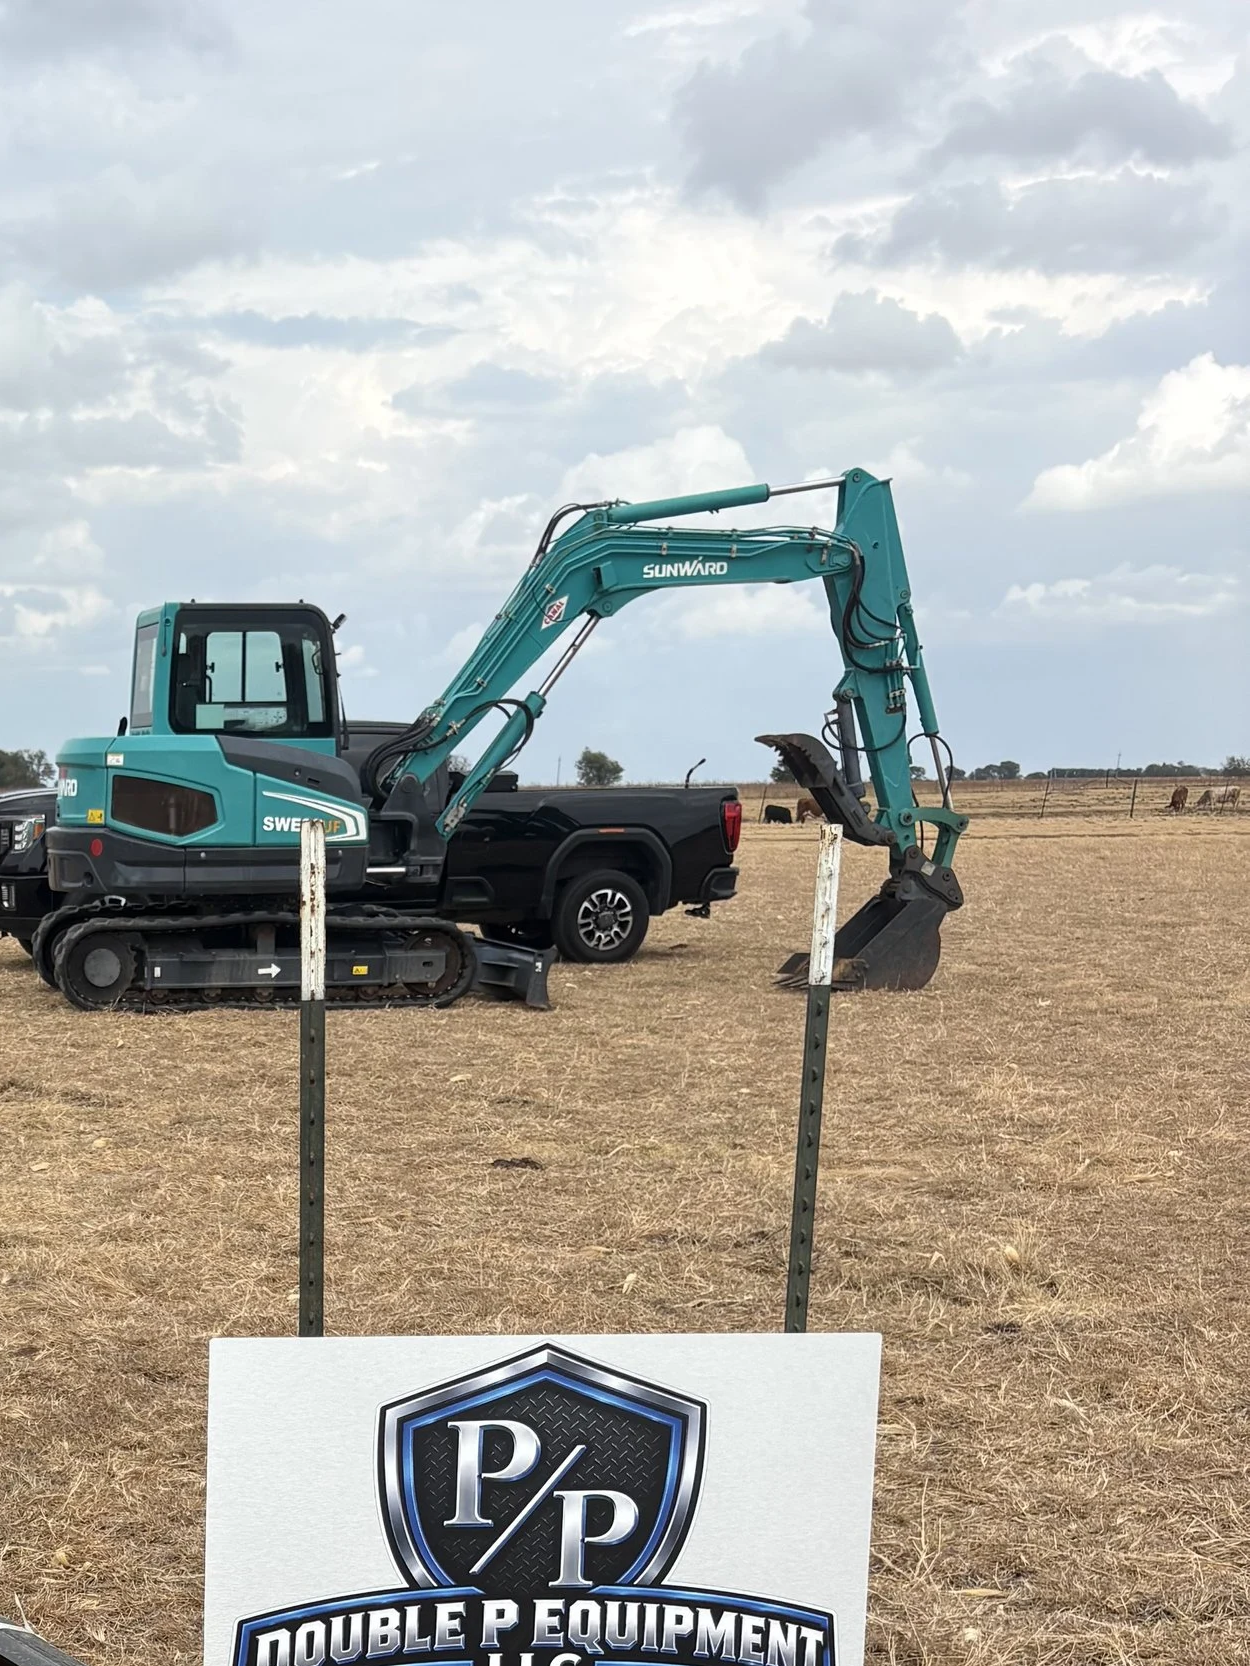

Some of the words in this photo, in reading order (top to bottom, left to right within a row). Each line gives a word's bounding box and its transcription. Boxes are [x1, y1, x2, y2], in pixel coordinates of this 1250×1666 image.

[642, 556, 728, 579] SUNWARD
[262, 816, 341, 834] SWEUF
[479, 1599, 519, 1648] P
